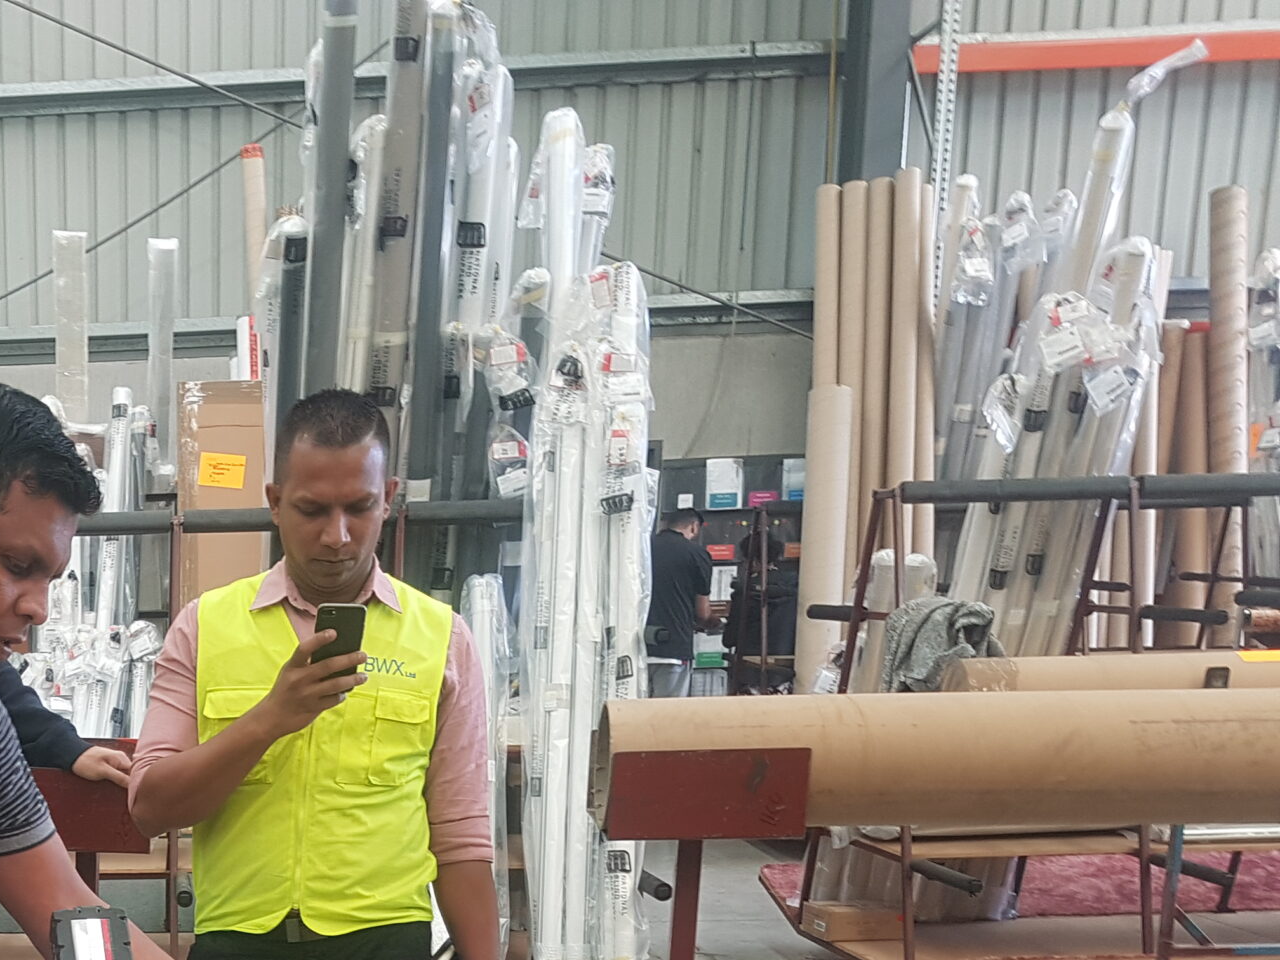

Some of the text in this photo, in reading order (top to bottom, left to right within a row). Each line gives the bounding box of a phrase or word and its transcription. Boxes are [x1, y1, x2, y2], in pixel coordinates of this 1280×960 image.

[458, 250, 467, 299] SUPPLIERS
[465, 250, 474, 277] BLIND
[470, 250, 481, 296] NATIONAL
[364, 656, 405, 676] BWX
[620, 874, 629, 916] NATIONAL
